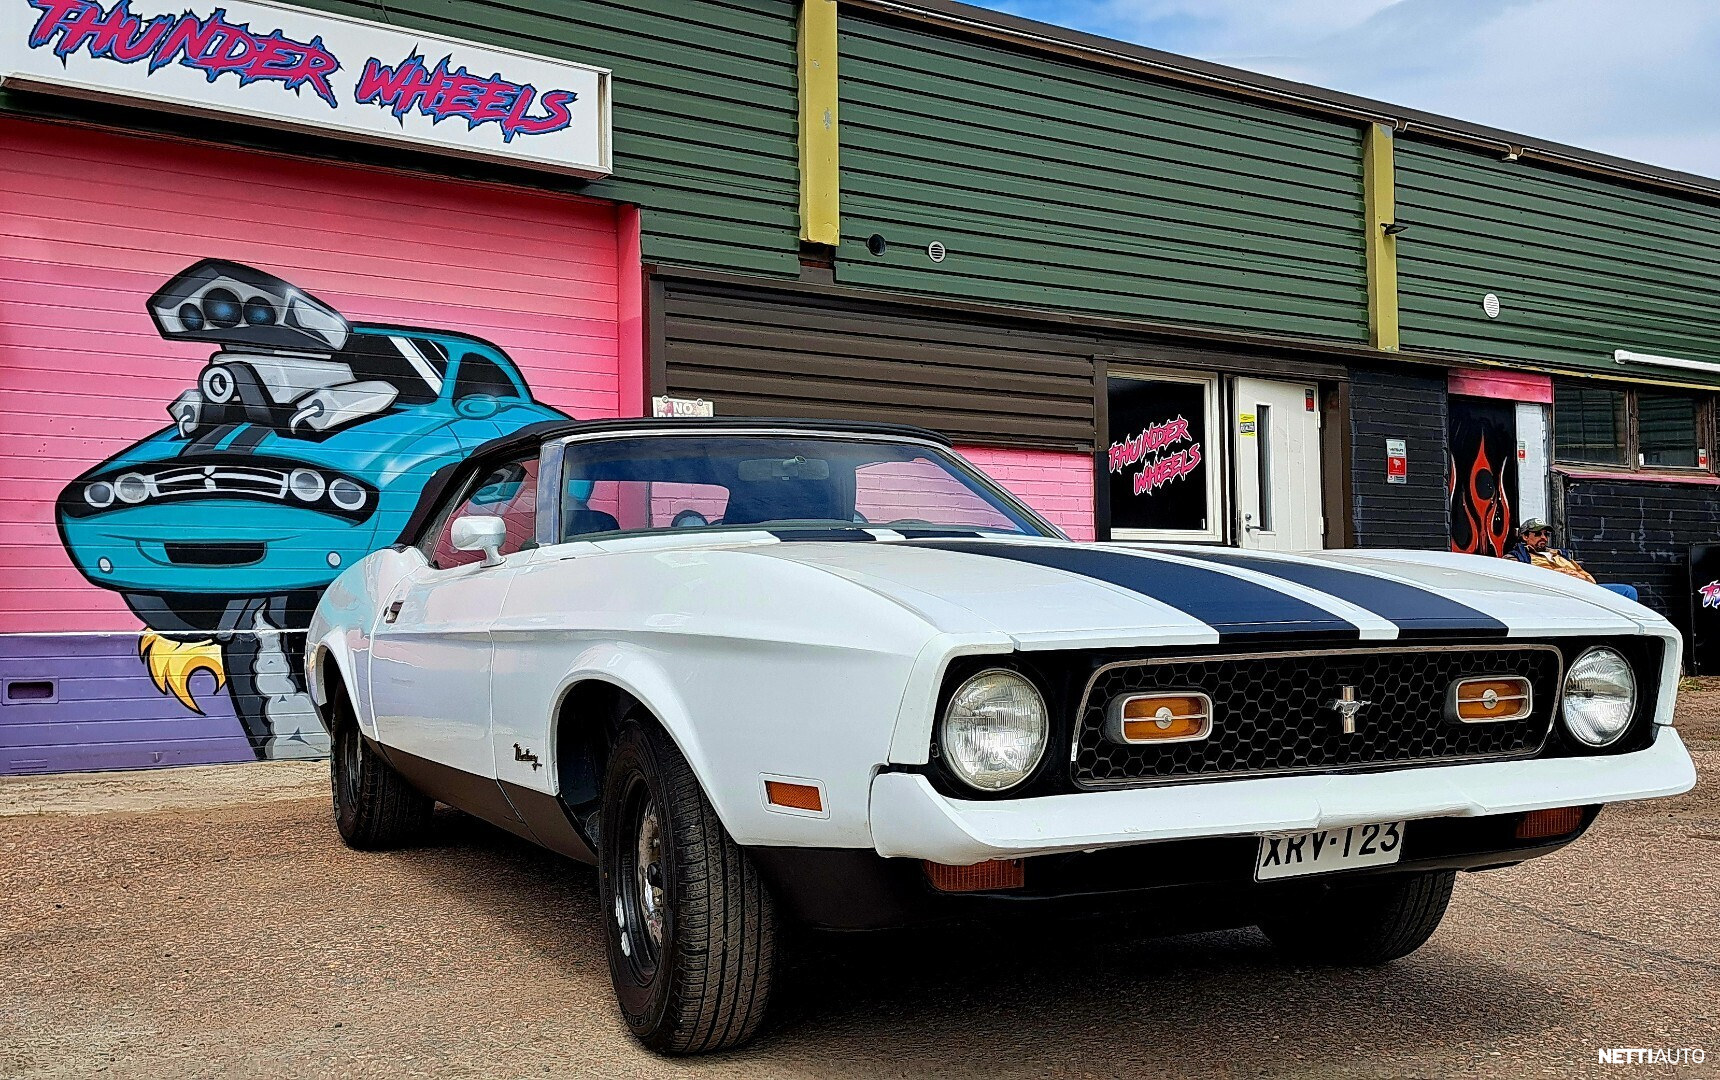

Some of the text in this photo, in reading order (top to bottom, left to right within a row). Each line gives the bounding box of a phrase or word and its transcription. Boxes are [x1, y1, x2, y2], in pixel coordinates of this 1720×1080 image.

[28, 0, 578, 143] THUNDER WHEELS
[1108, 414, 1192, 475] THUNDER
[1133, 442, 1201, 496] WHEELS
[1262, 821, 1400, 868] XRV-123
